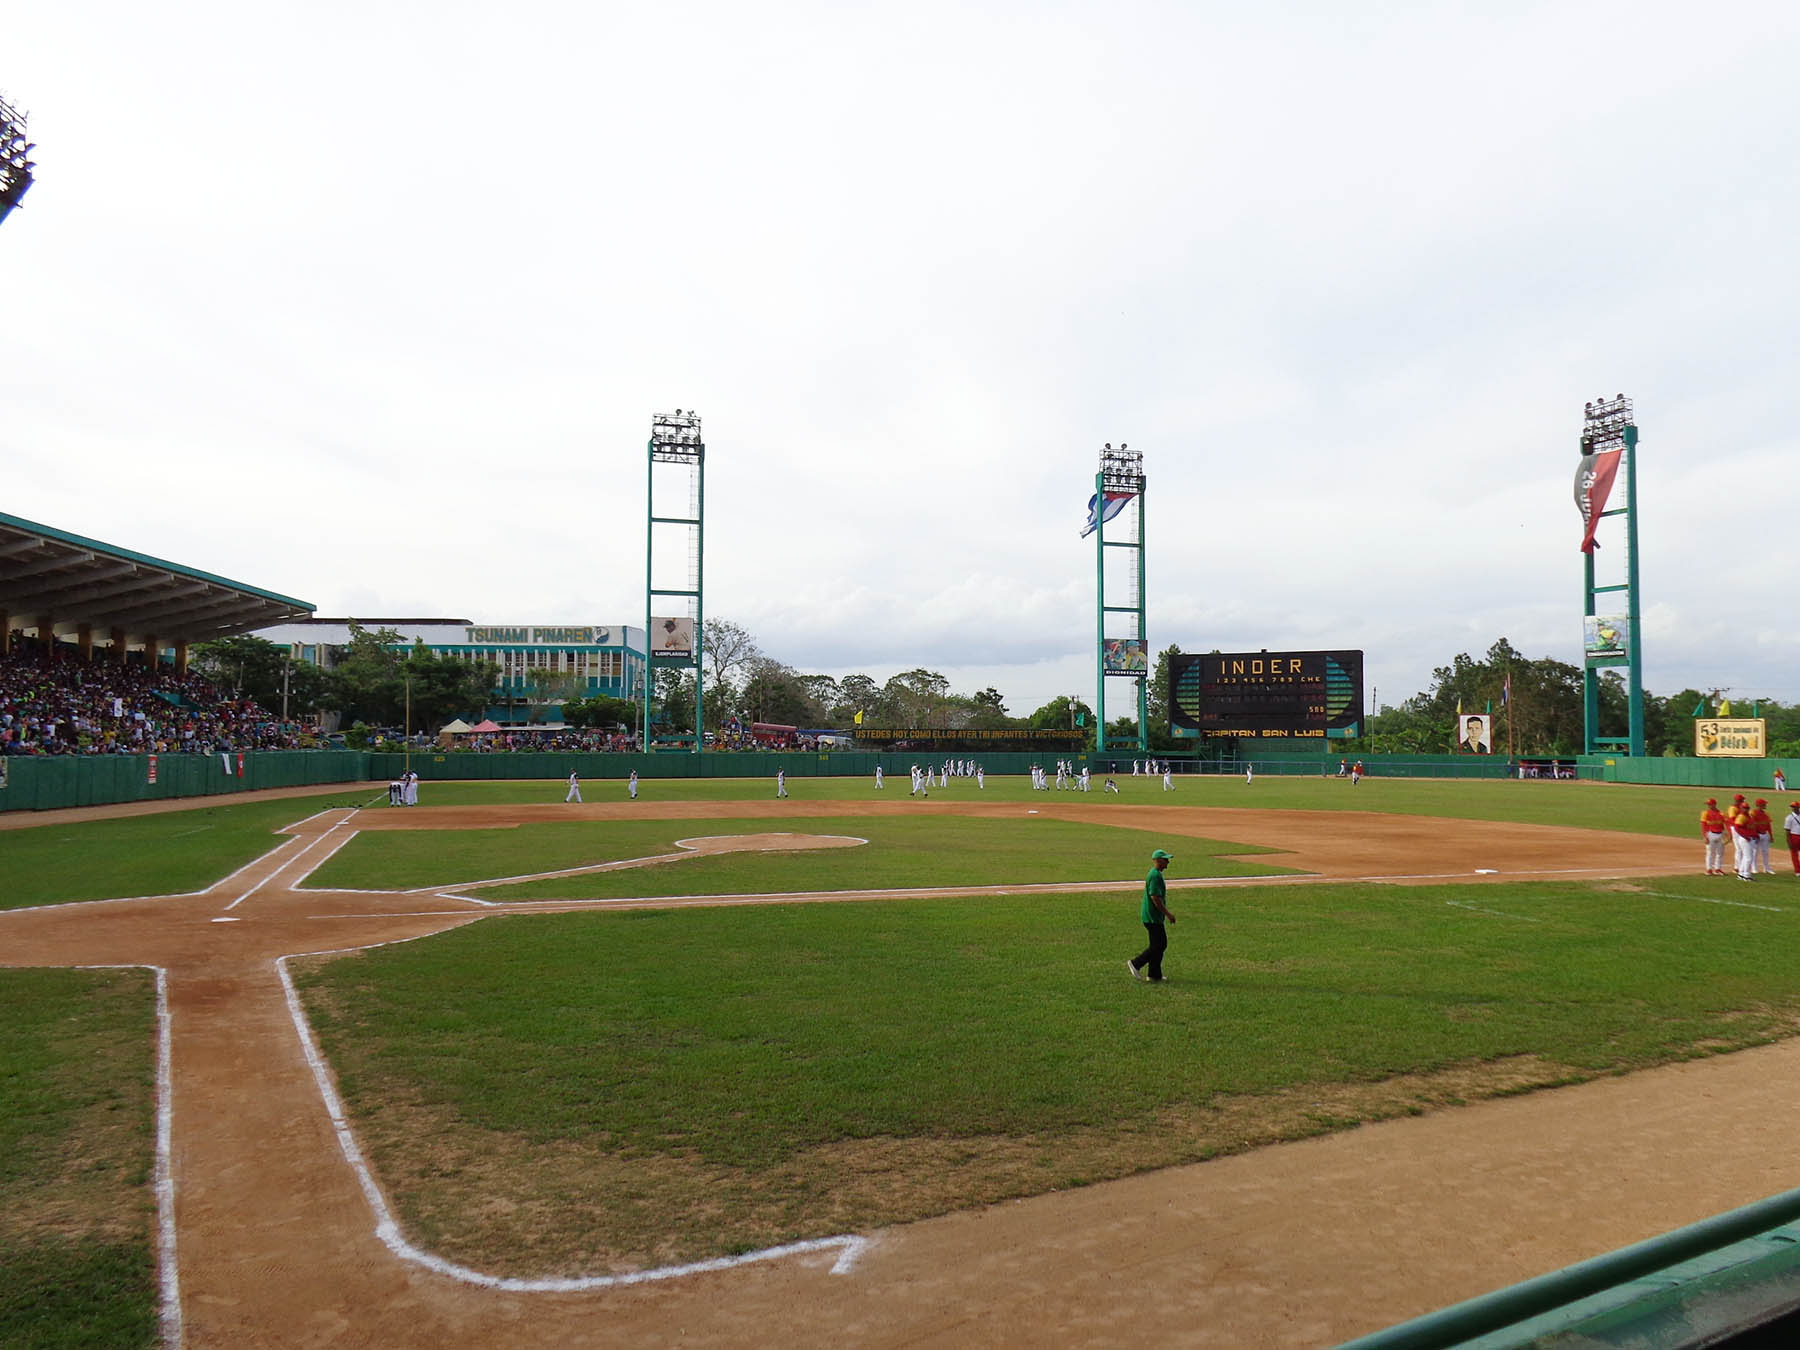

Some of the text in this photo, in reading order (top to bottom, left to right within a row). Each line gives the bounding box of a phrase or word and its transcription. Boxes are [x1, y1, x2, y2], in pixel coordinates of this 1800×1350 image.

[1581, 471, 1597, 489] 26
[465, 627, 529, 643] TSUNAMI
[1221, 659, 1302, 675] INDER
[855, 729, 891, 739] USTEDES
[892, 729, 907, 739] HOY
[909, 729, 931, 739] COMO
[932, 729, 957, 739] ELLOS
[1262, 729, 1288, 737] SAN
[1294, 729, 1325, 737] LUIS
[1701, 723, 1719, 739] 53
